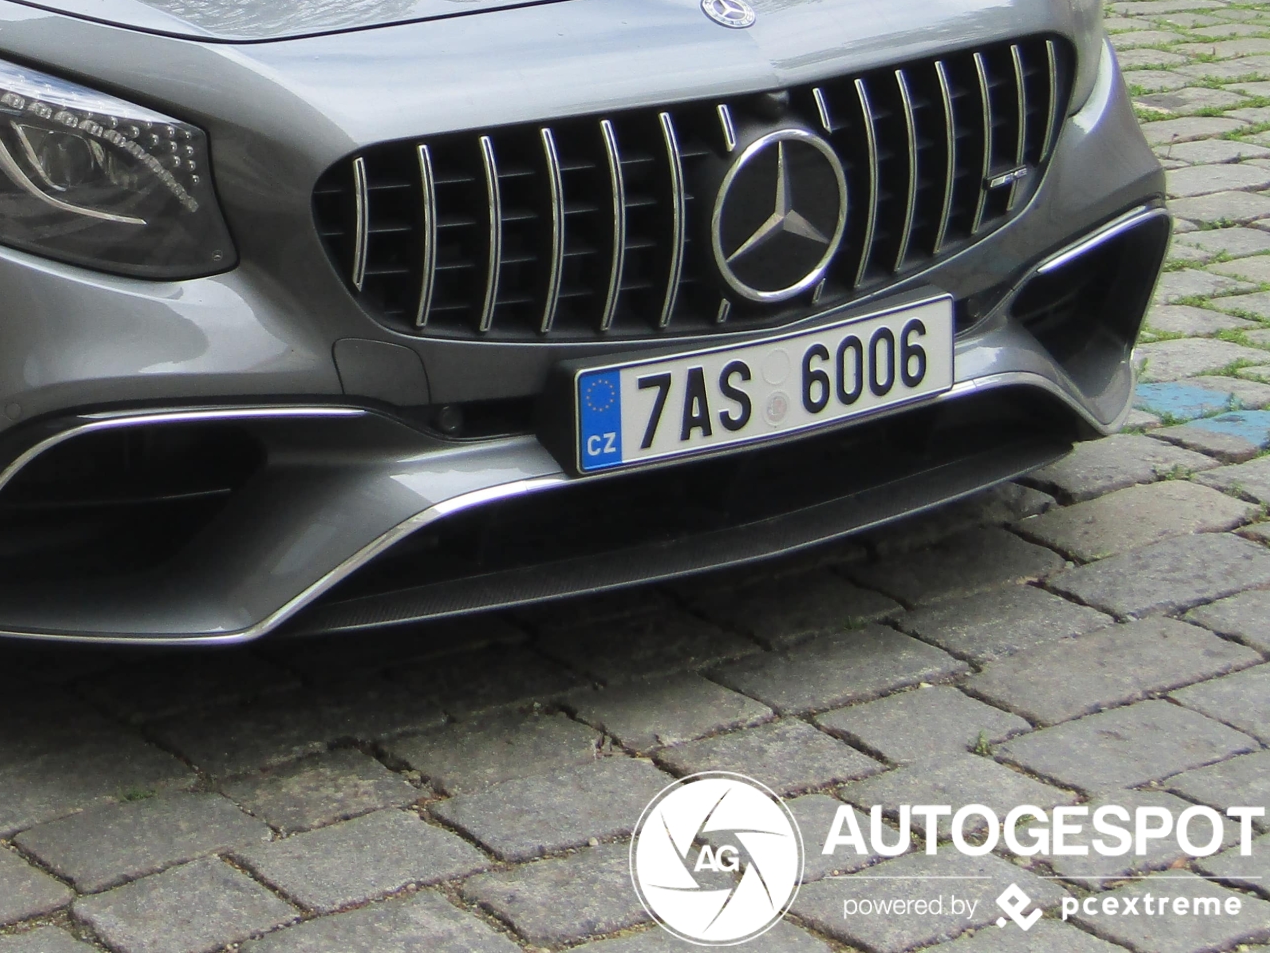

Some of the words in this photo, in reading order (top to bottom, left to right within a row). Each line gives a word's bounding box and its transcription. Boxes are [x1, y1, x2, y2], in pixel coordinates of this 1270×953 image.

[637, 360, 752, 450] 7AS
[801, 318, 927, 414] 6006
[587, 432, 617, 456] CZ
